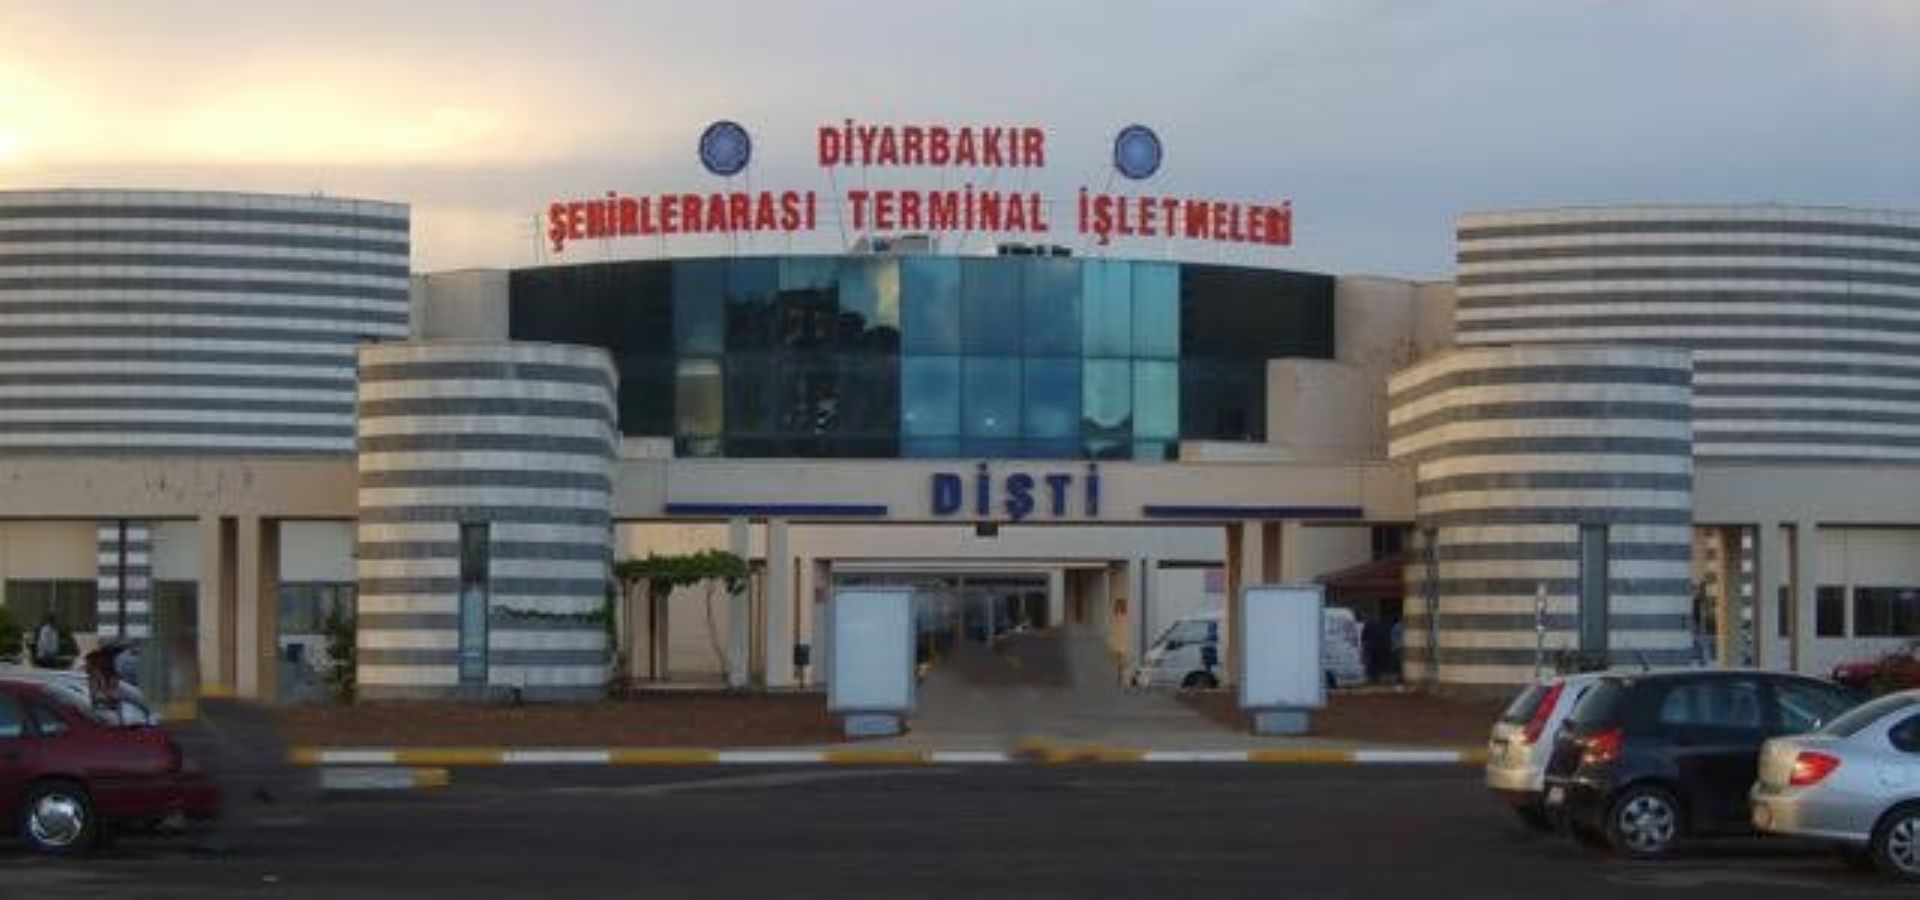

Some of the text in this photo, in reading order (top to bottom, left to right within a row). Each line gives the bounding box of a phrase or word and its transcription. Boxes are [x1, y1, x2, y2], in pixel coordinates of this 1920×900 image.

[818, 118, 1045, 168] DİYARBAKIR
[549, 184, 1293, 251] ŞEHİRLERARASI TERMİNAL İŞLETMELERİ
[932, 462, 1099, 522] DİŞTİ
